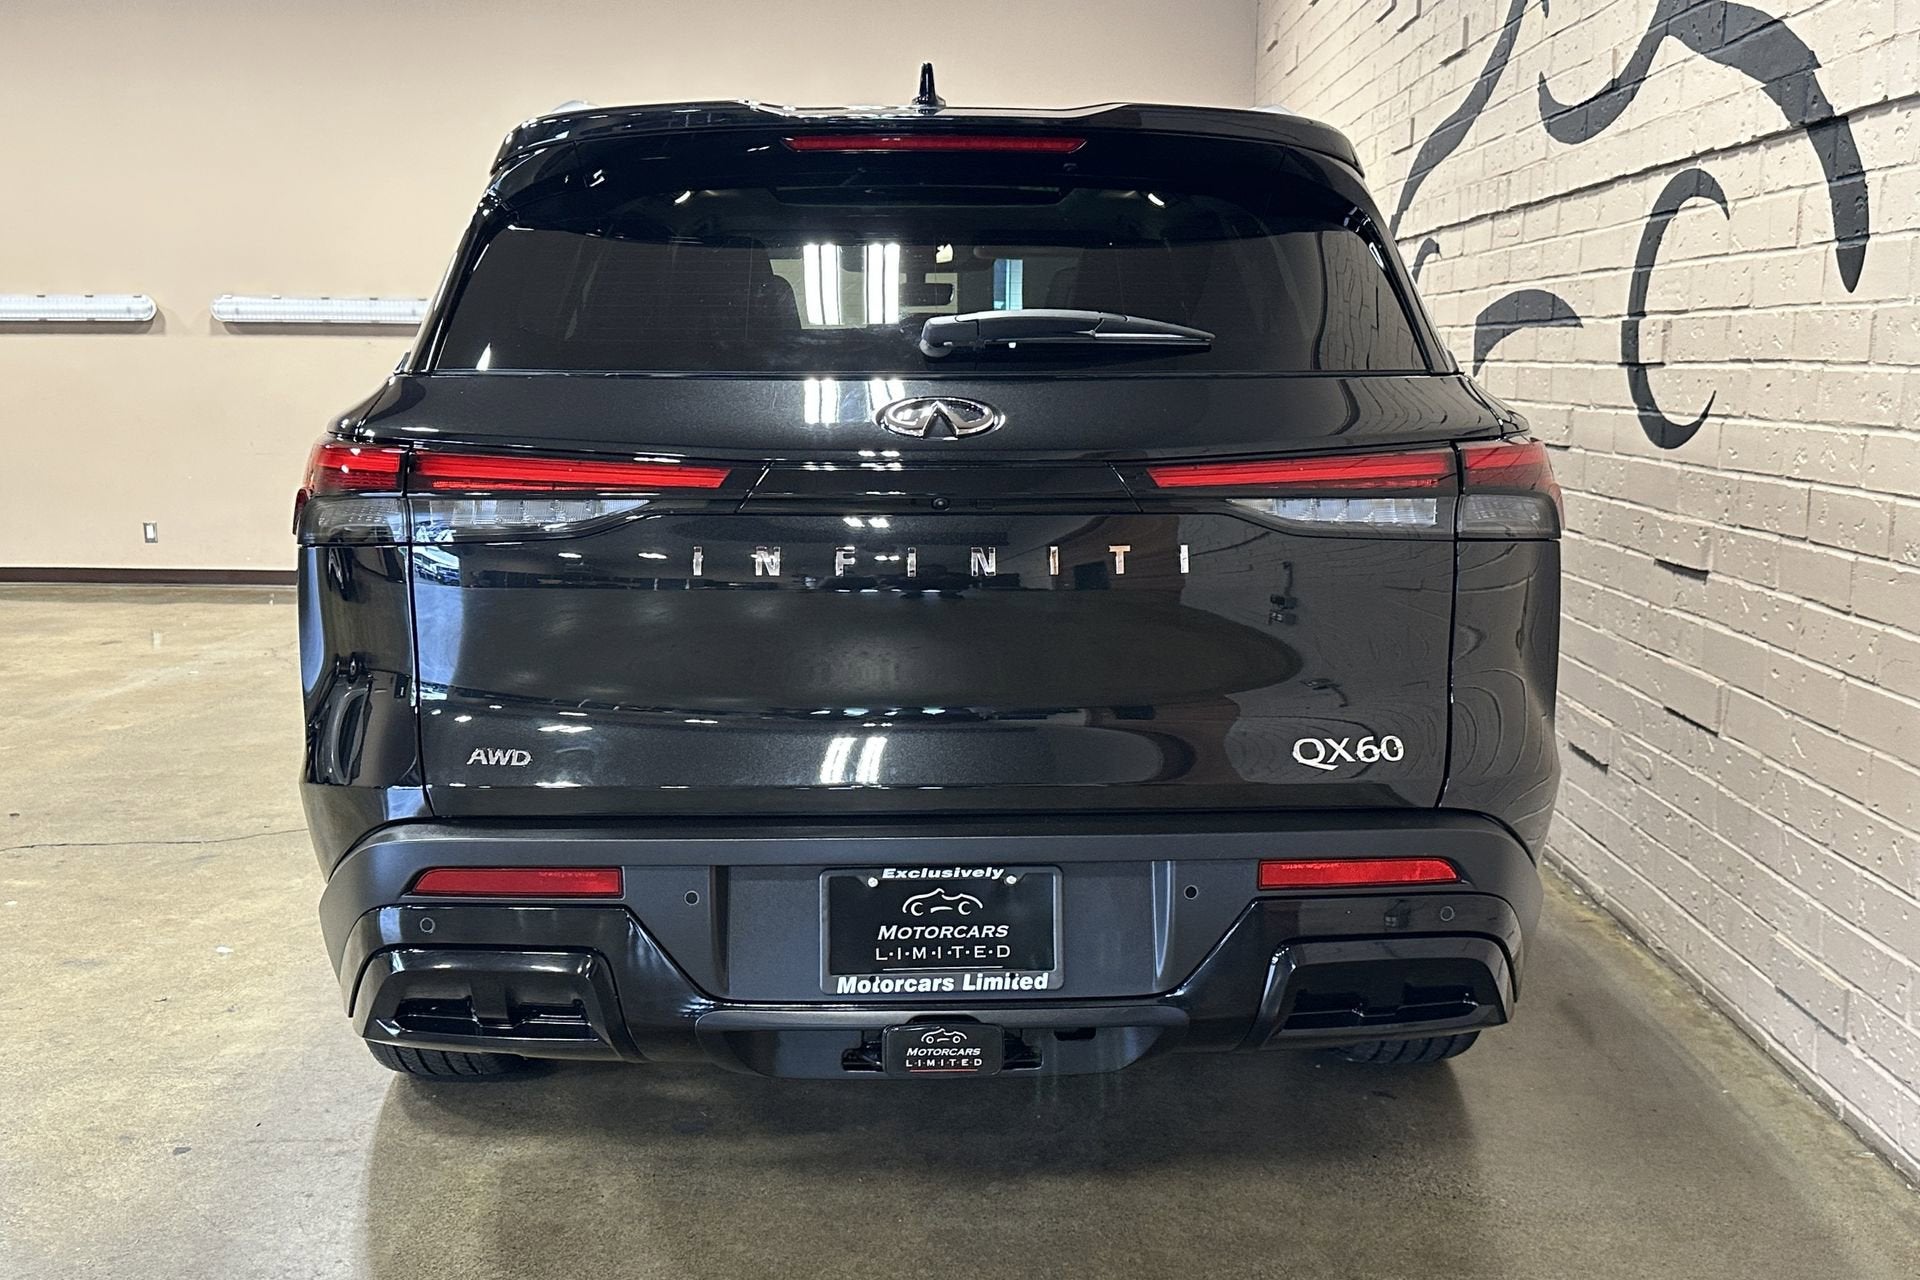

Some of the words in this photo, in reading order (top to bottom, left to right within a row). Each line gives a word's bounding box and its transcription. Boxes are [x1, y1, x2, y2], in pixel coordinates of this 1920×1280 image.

[692, 545, 1191, 578] INFINITI
[466, 748, 533, 767] AWD
[1292, 735, 1405, 771] QX60
[882, 867, 1004, 880] Exclusively
[836, 975, 955, 994] Motorcars
[962, 972, 1049, 990] Limited
